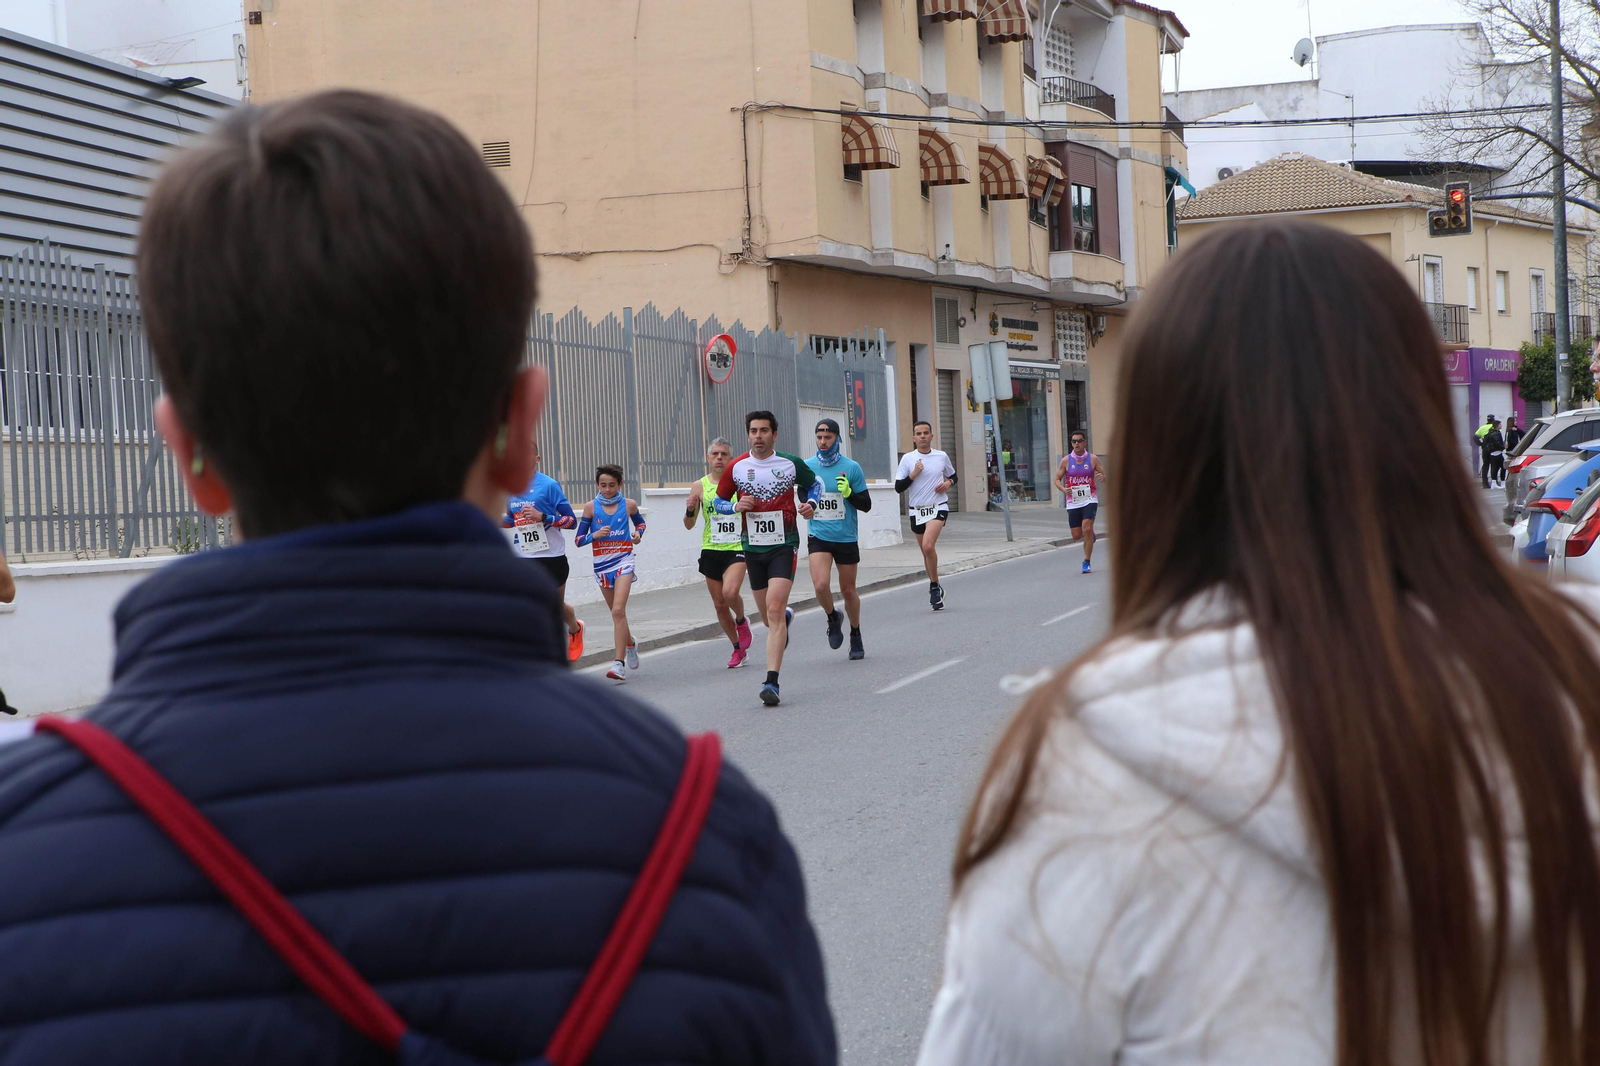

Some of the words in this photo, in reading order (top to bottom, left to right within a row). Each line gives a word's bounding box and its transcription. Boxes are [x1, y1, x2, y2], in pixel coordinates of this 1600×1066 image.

[1484, 358, 1515, 372] ORALDENT
[855, 380, 865, 429] 5
[818, 500, 838, 510] 696
[920, 508, 934, 516] 676
[717, 522, 735, 533] 768
[754, 520, 776, 533] 730
[522, 530, 540, 543] 726
